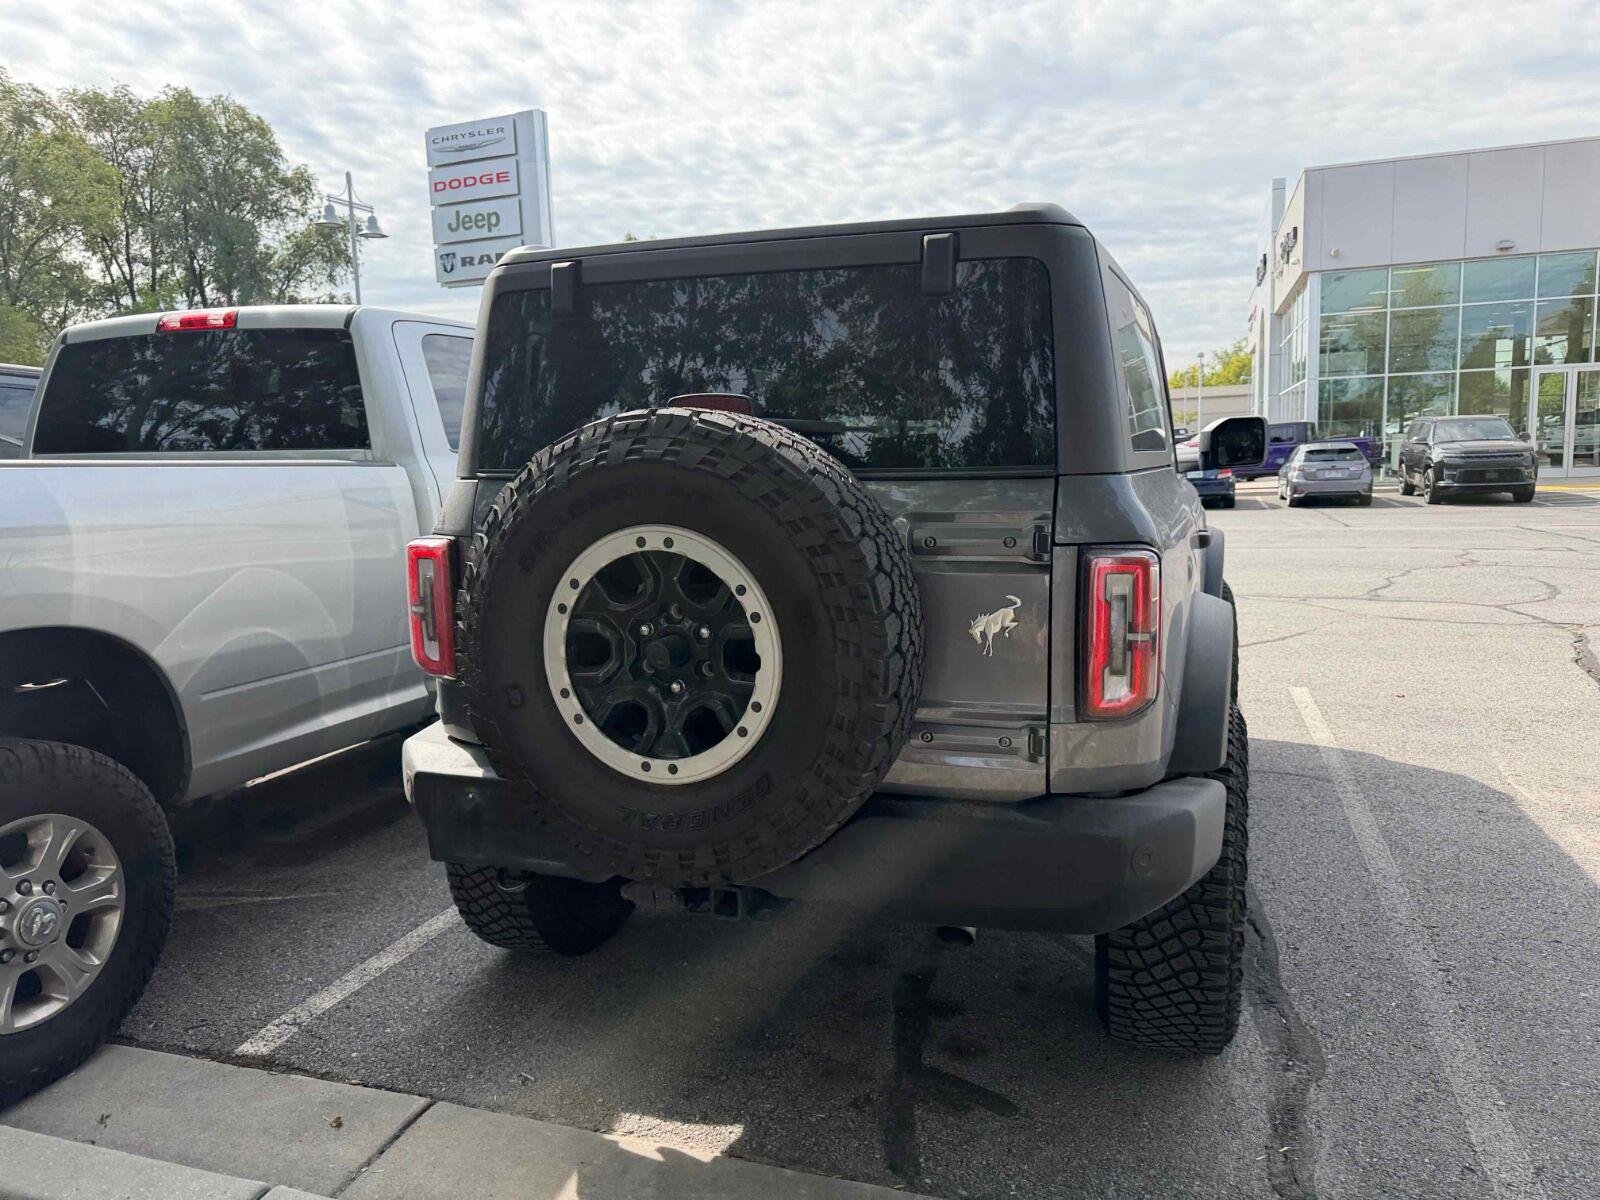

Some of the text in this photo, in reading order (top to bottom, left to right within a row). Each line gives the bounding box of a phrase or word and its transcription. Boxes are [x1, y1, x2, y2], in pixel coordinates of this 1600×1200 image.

[432, 126, 505, 145] CHRYSLER
[433, 171, 510, 192] DODGE
[448, 209, 500, 232] Jeep
[616, 774, 773, 833] GENERAL
